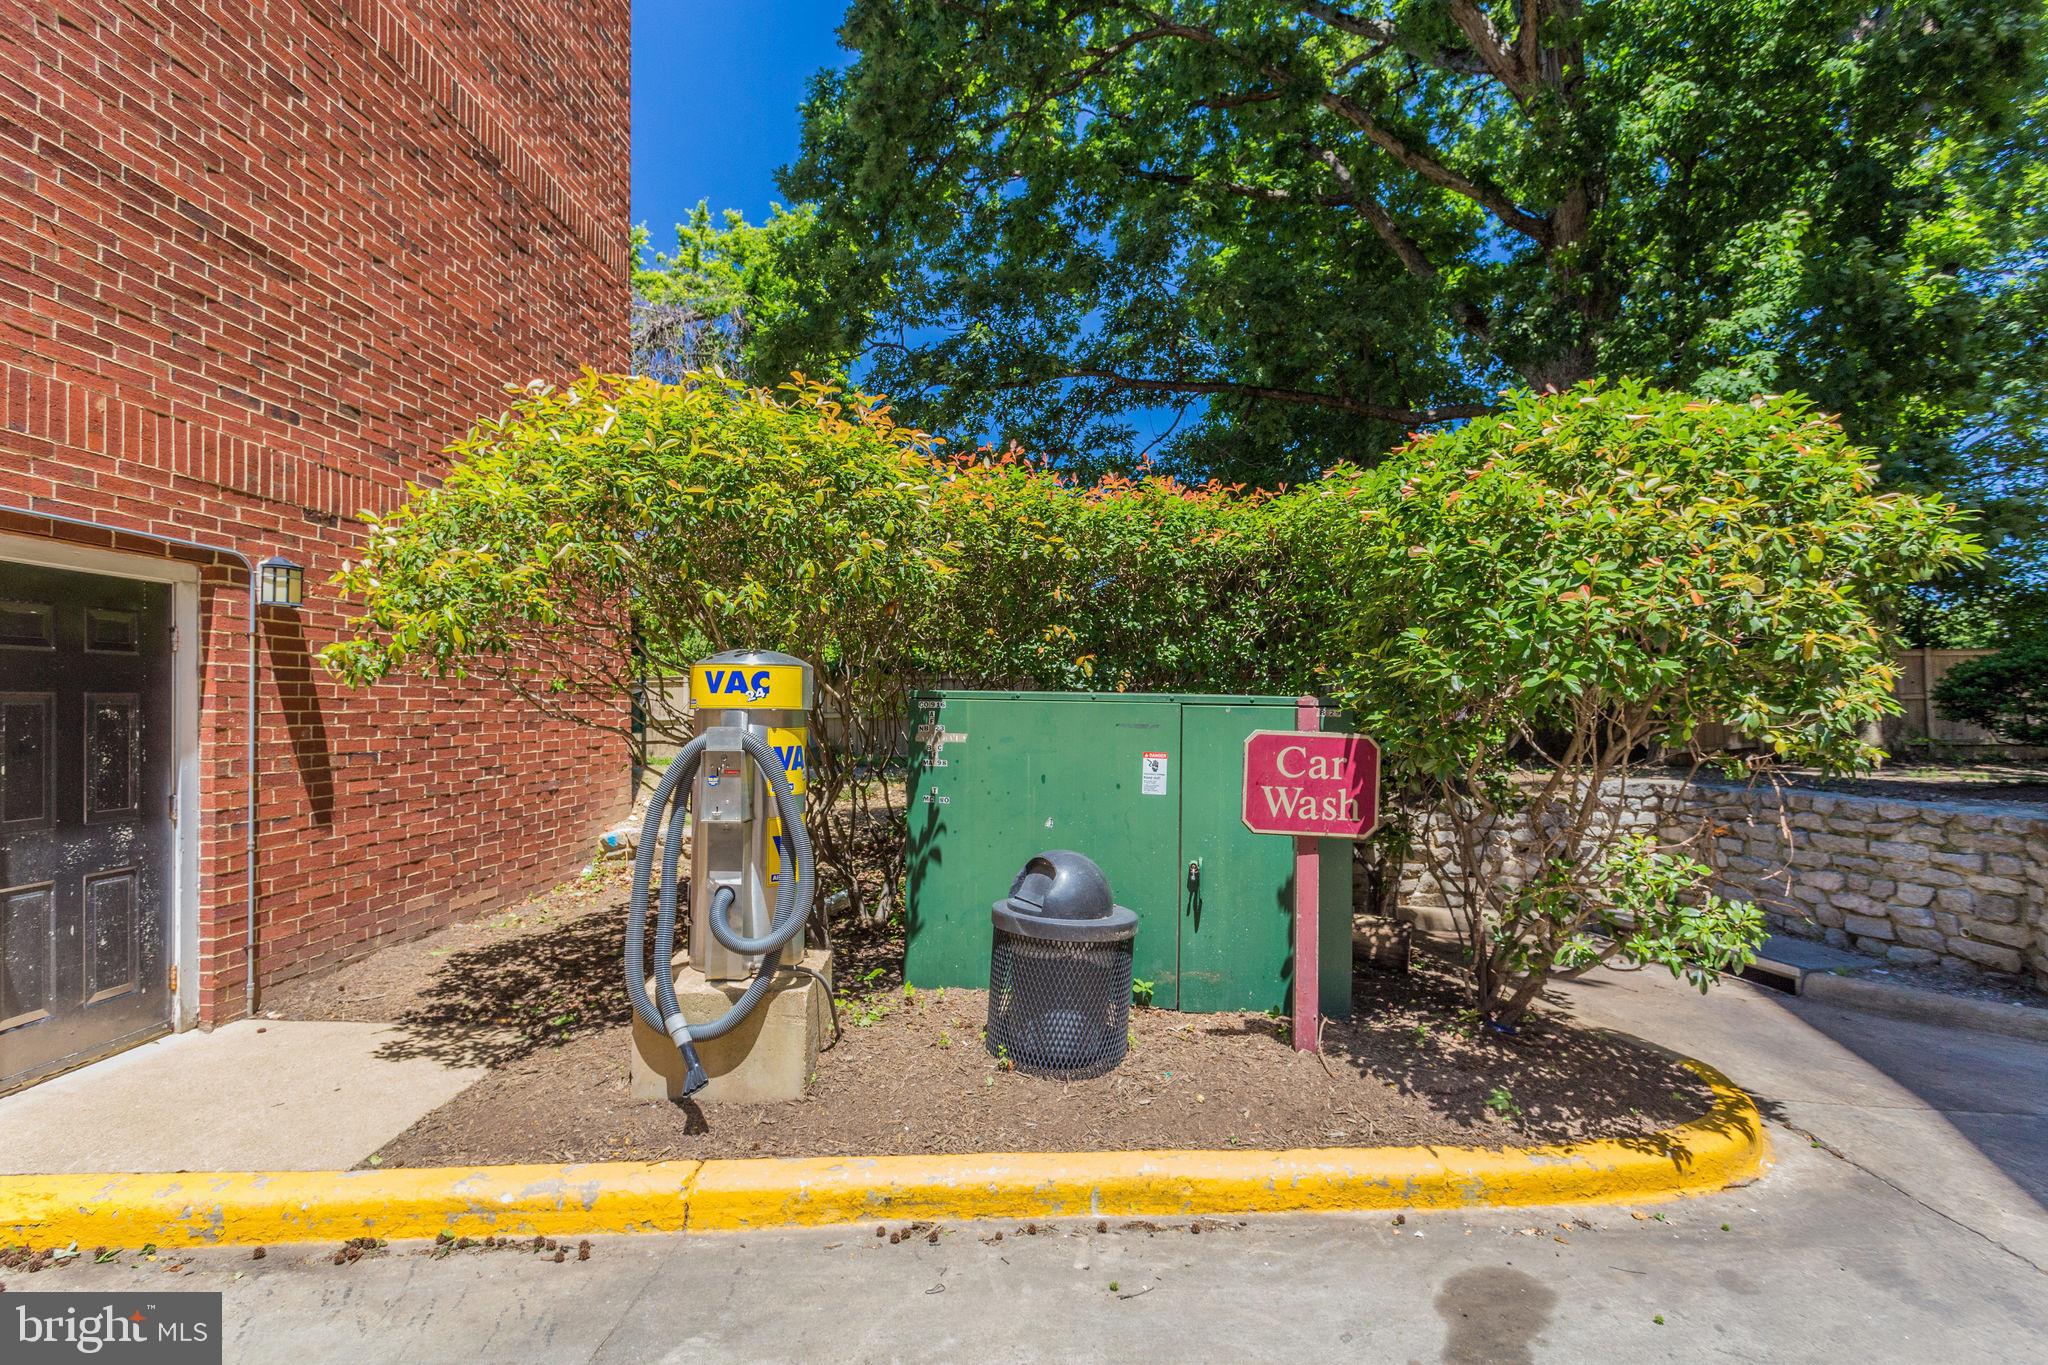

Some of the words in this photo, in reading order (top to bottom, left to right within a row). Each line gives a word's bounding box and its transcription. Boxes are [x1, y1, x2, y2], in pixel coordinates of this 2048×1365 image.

[705, 671, 770, 694] VAC
[746, 688, 765, 702] 24
[773, 746, 804, 771] VA
[1276, 746, 1347, 780] Car
[1260, 785, 1361, 821] Wash
